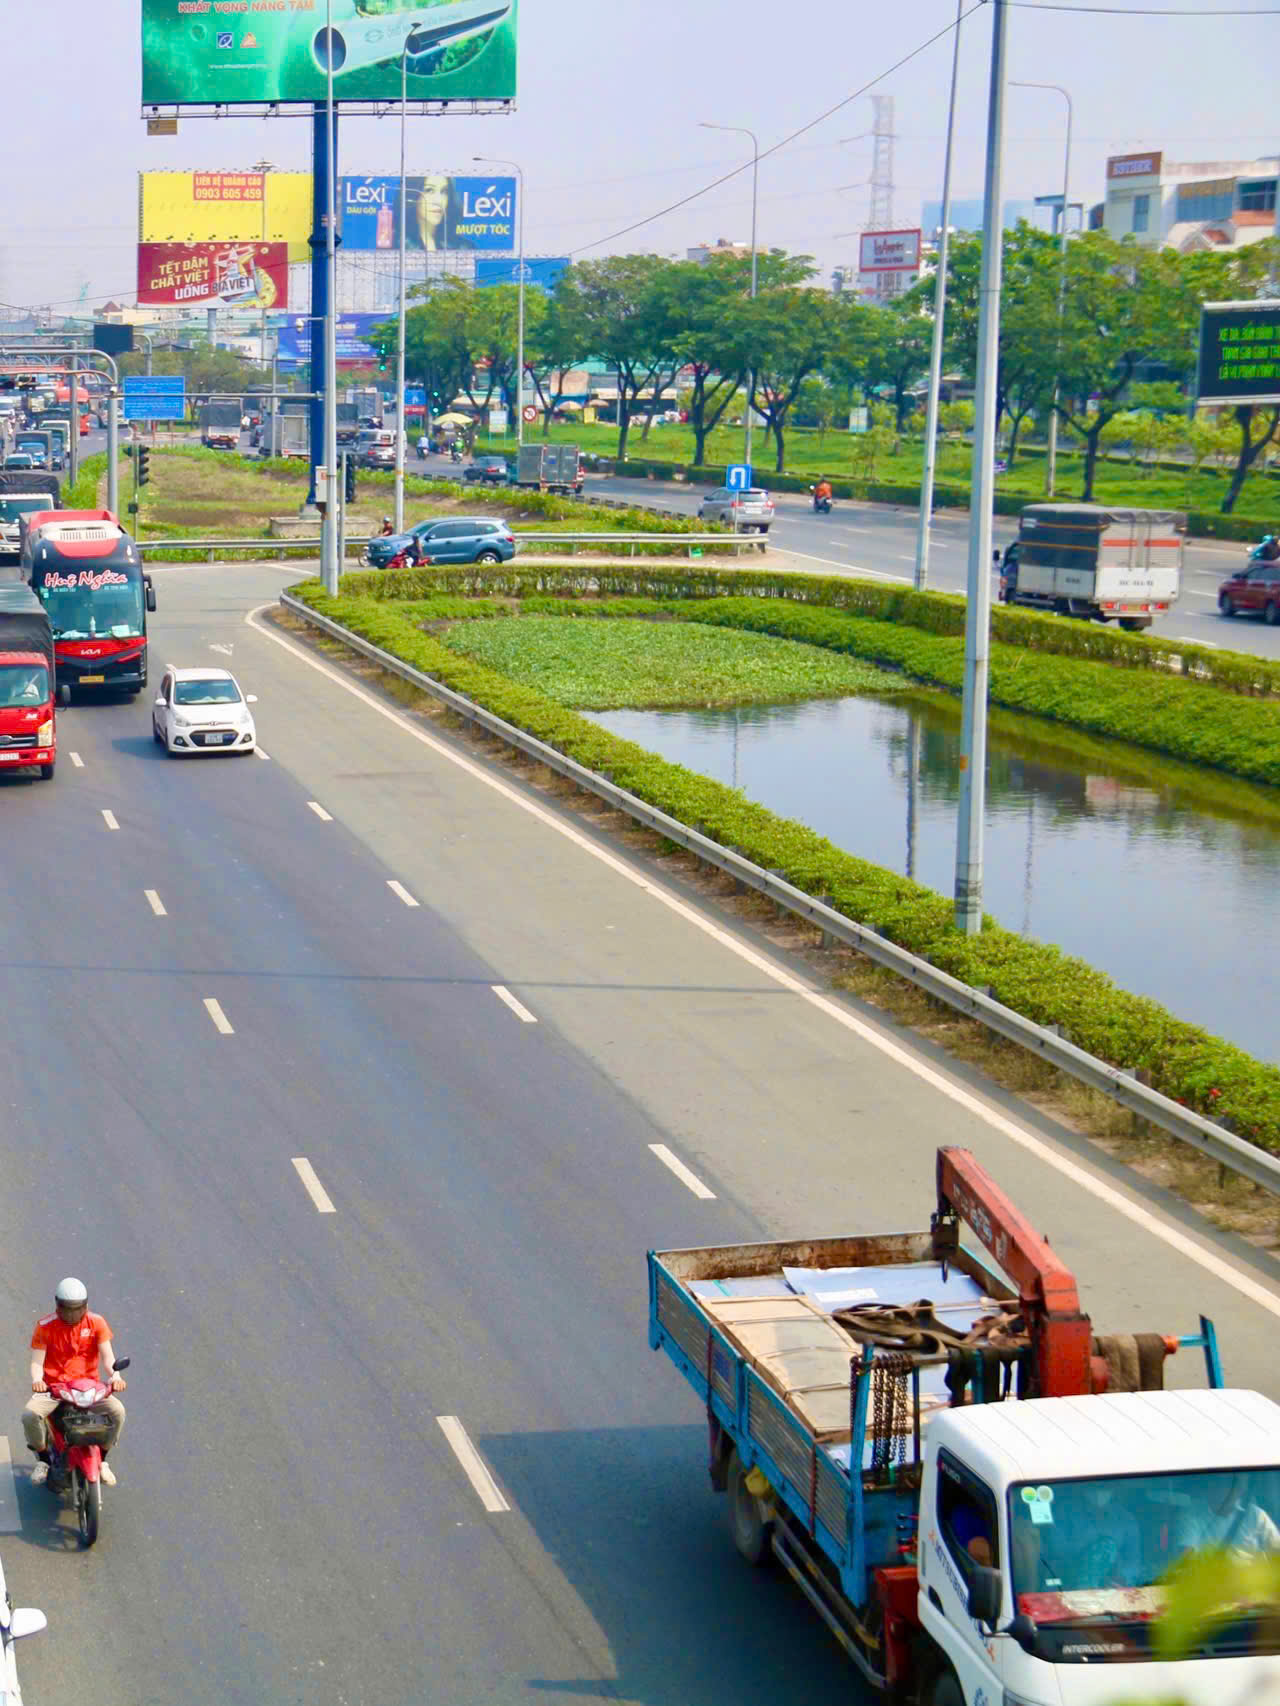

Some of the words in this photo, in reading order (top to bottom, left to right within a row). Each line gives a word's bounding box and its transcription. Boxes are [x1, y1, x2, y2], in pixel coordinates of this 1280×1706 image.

[196, 188, 220, 199] 0903
[222, 188, 241, 199] 605
[243, 188, 262, 199] 459
[455, 223, 488, 237] MƯỢT
[78, 569, 129, 590] Nghĩa
